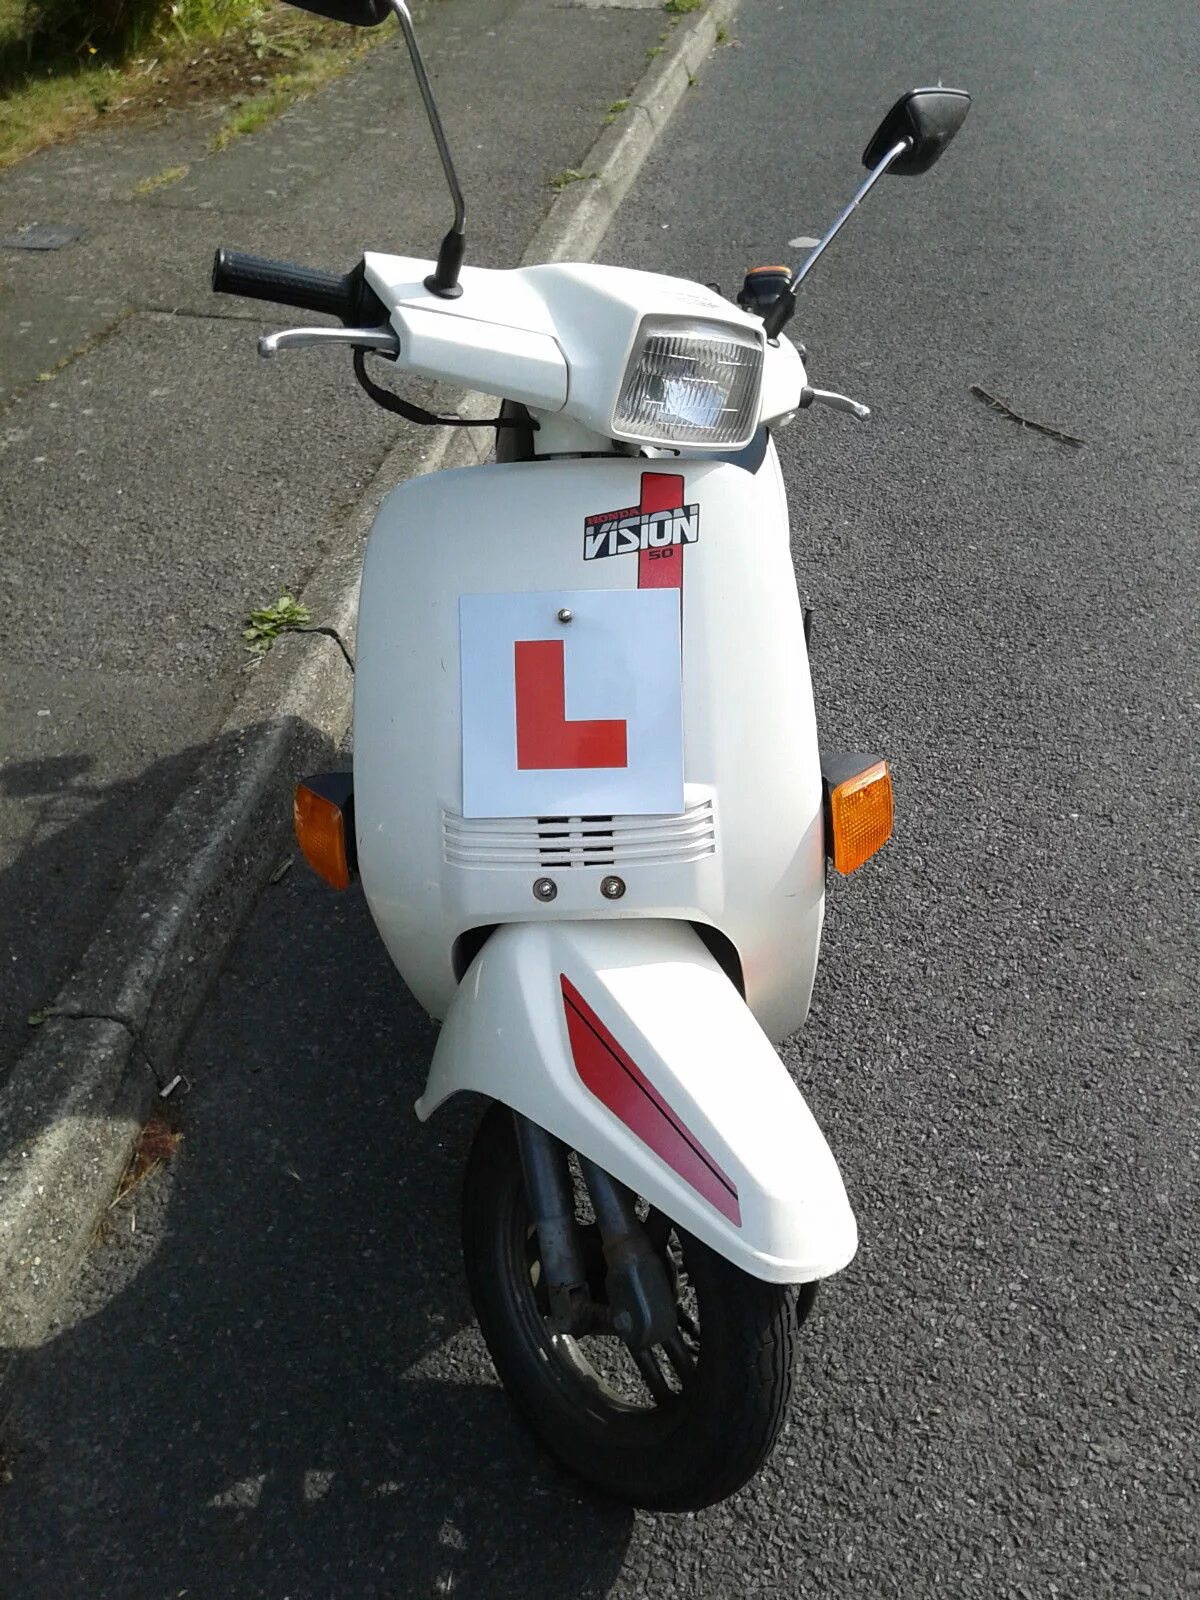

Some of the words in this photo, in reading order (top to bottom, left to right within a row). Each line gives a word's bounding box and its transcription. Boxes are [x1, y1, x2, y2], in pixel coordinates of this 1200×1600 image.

[585, 505, 699, 559] VISION
[587, 508, 640, 525] HONDA
[648, 547, 674, 560] 50
[515, 640, 627, 769] L
